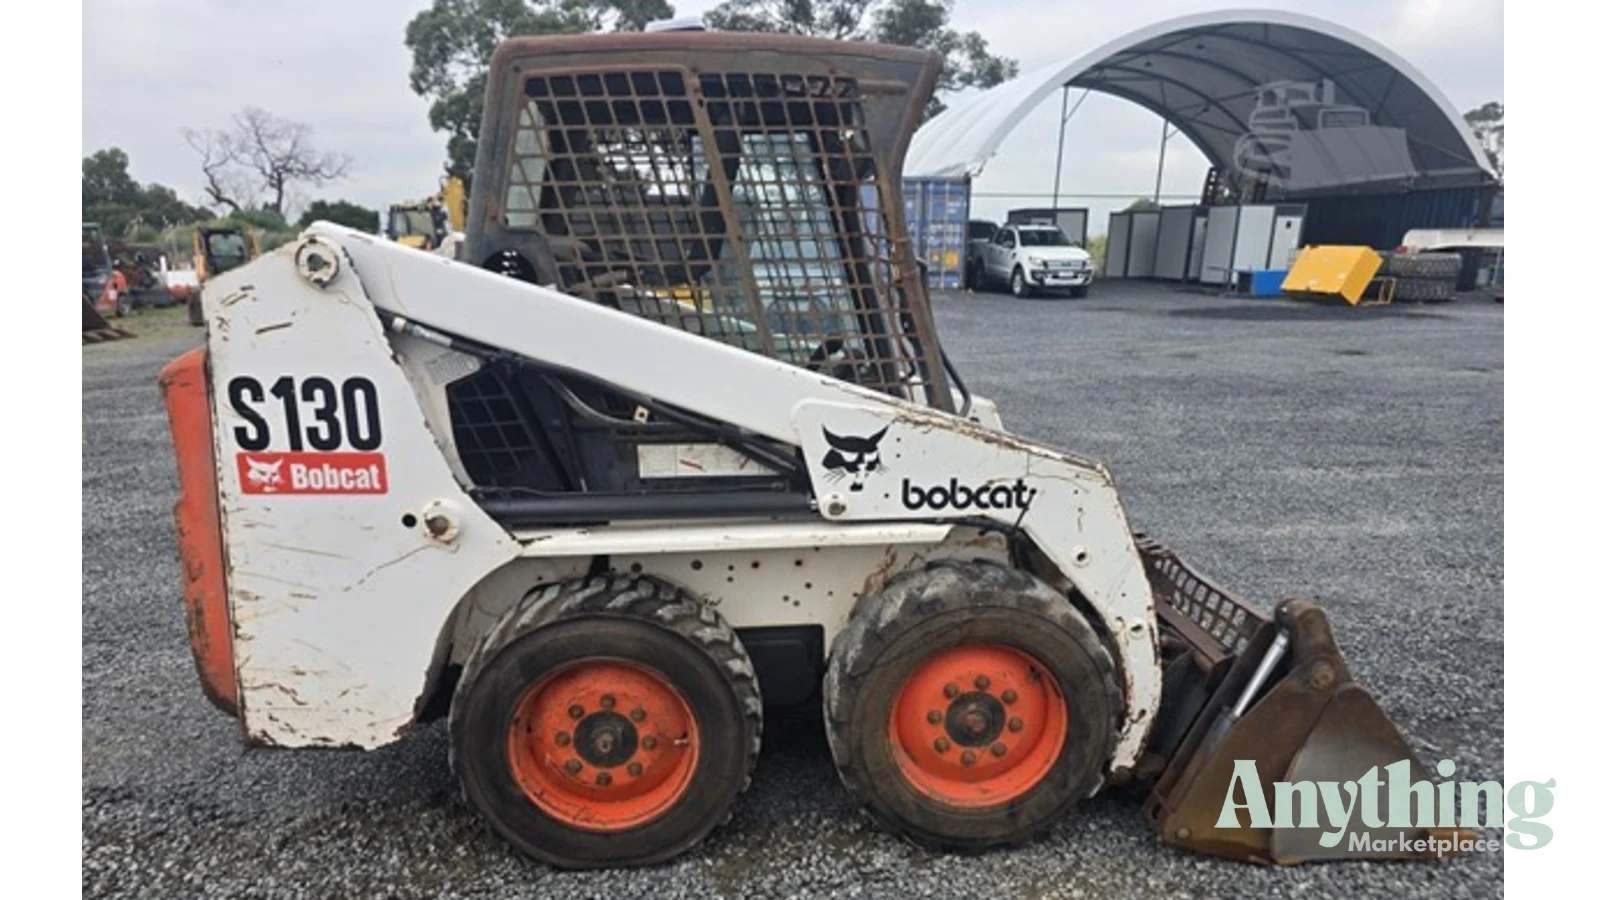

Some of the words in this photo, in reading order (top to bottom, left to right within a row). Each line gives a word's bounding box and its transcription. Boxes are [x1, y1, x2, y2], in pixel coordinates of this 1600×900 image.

[228, 375, 382, 452] S130
[290, 463, 381, 490] Bobcat
[902, 478, 1032, 511] bobcat
